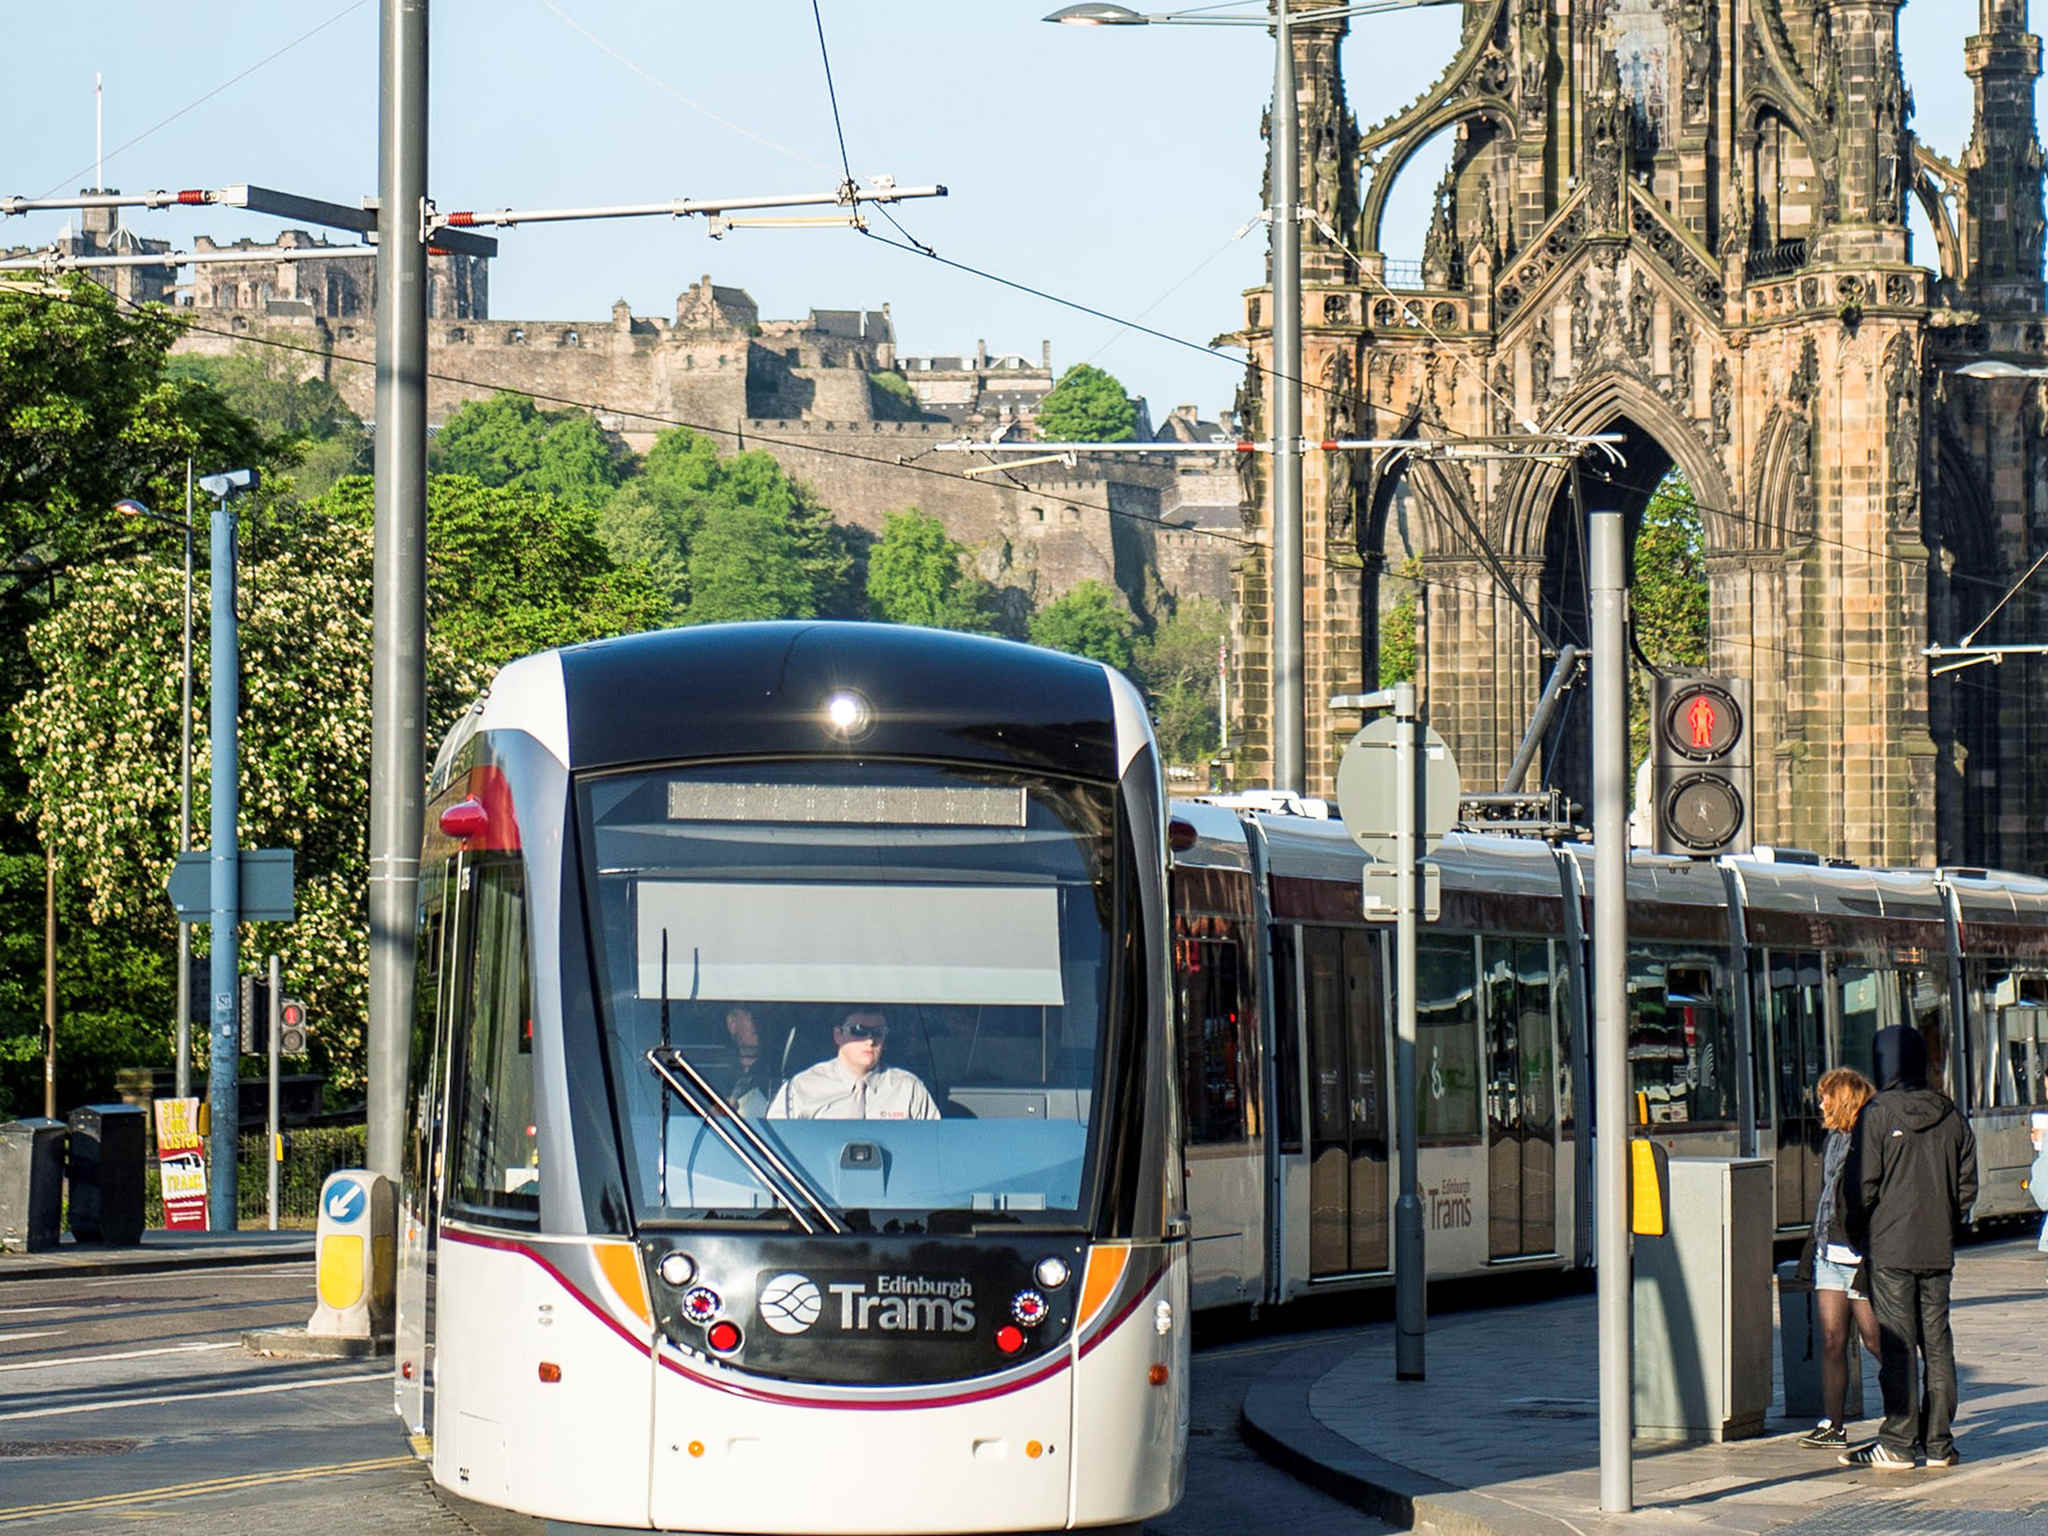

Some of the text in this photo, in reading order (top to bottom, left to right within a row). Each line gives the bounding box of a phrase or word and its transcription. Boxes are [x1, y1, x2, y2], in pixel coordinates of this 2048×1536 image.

[164, 1134, 198, 1149] LISTEN
[1441, 1178, 1471, 1197] Edinburgh
[1428, 1188, 1472, 1230] Trams
[877, 1275, 973, 1299] Edinburgh
[829, 1283, 976, 1332] Trams
